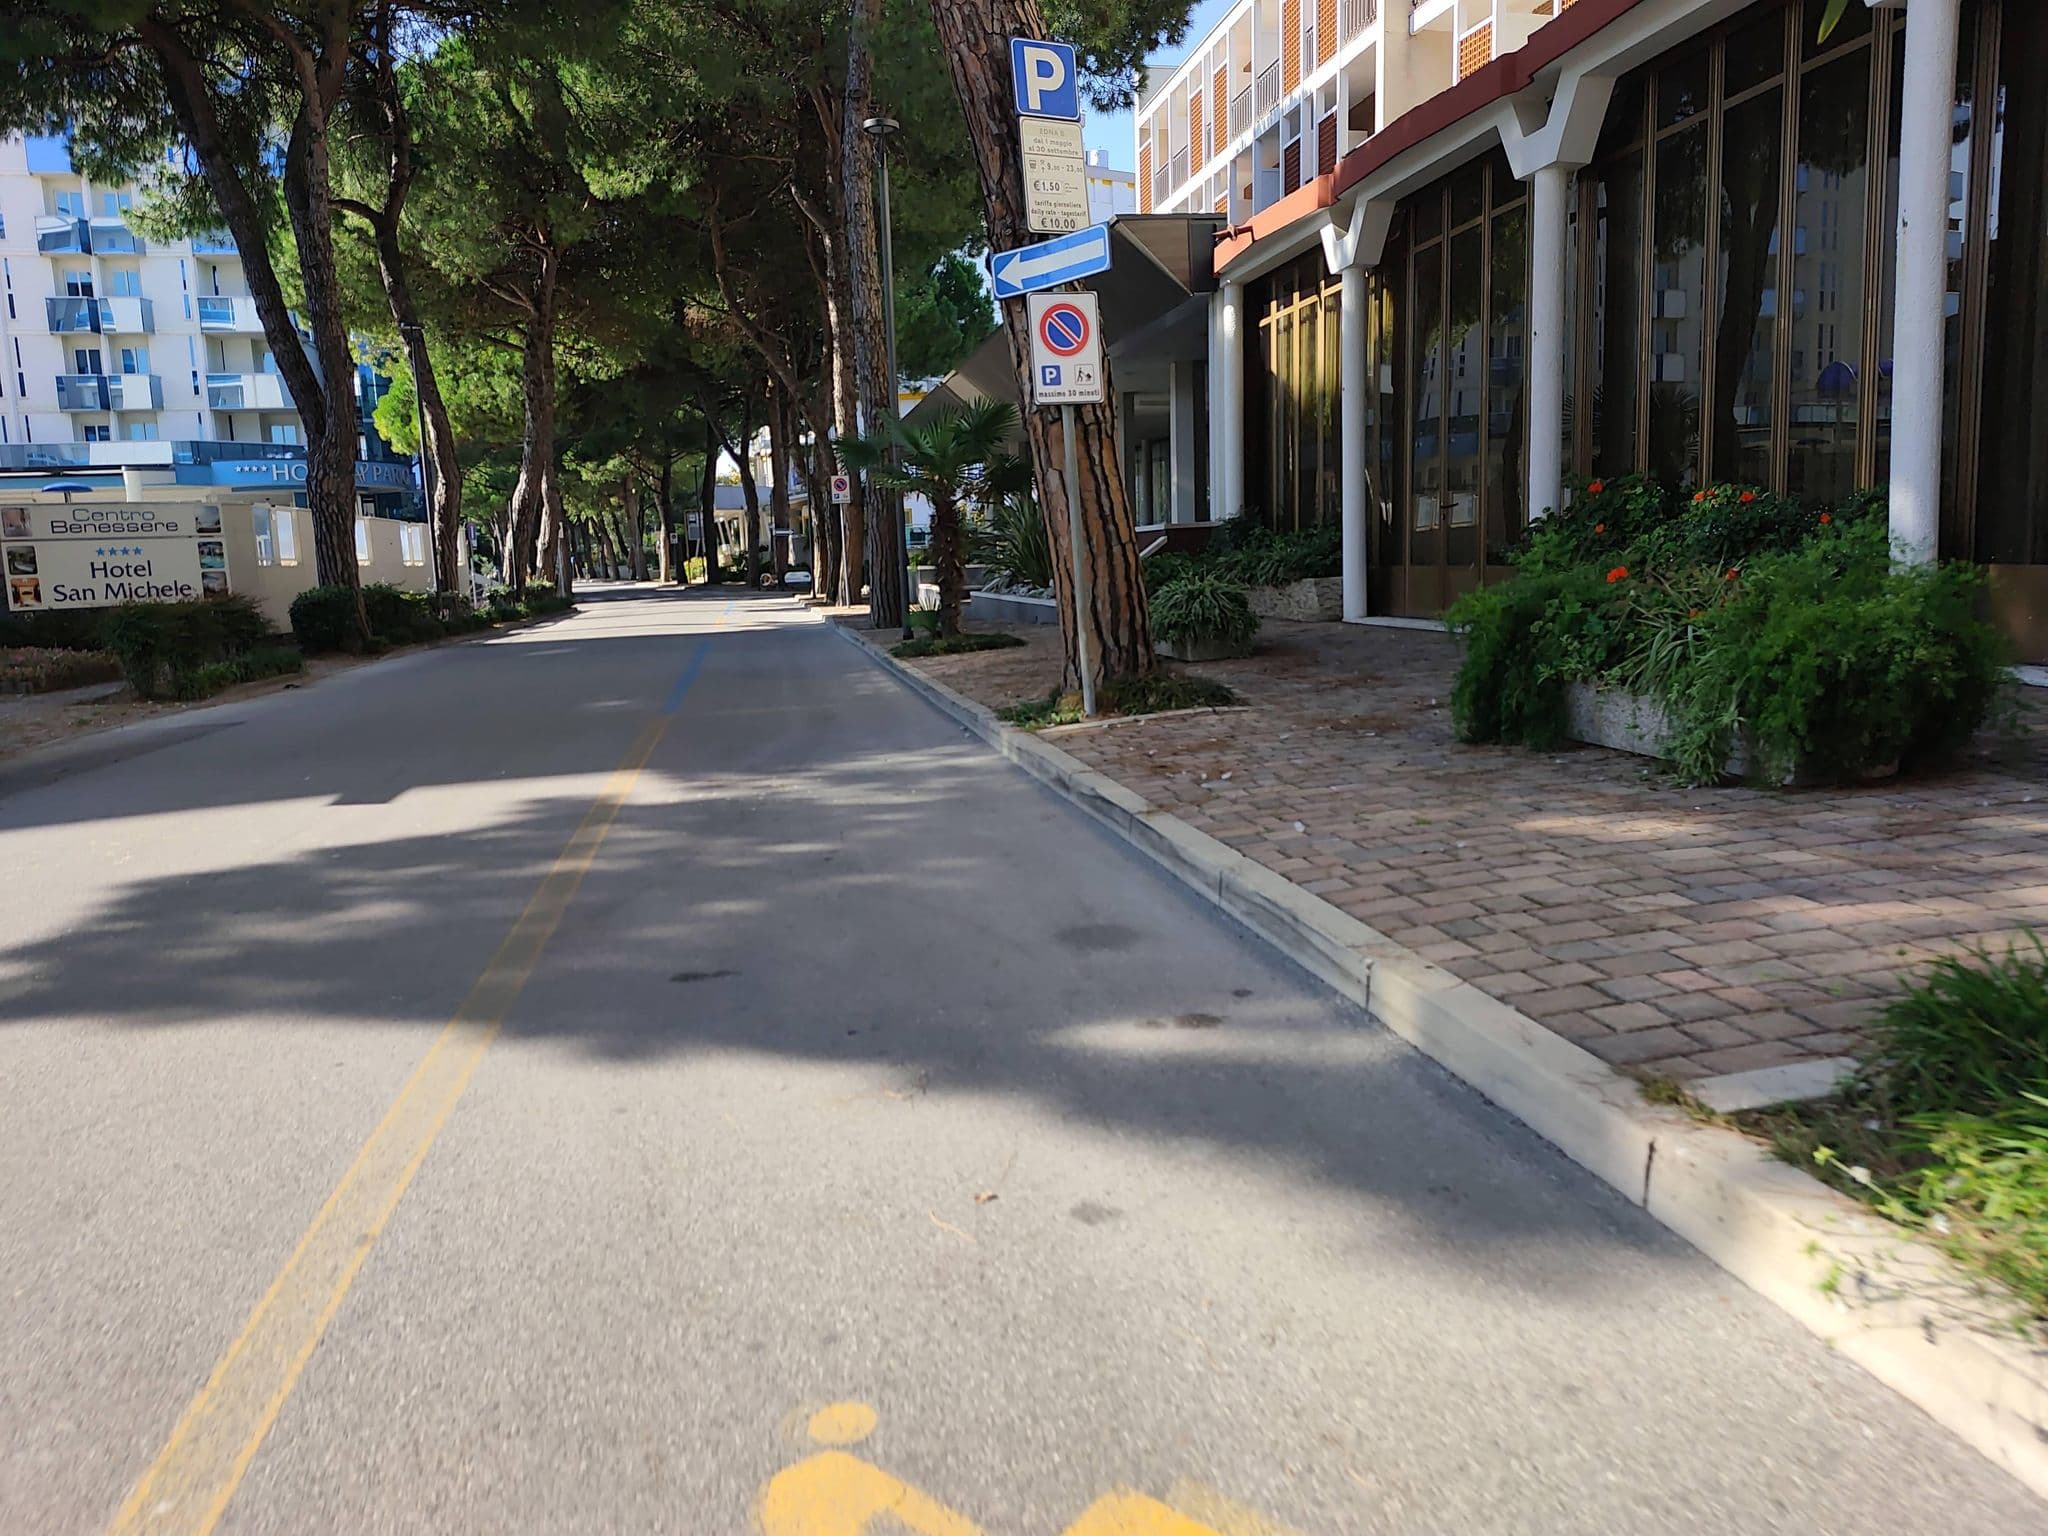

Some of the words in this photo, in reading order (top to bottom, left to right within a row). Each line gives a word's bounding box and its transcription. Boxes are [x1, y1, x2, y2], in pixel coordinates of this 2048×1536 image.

[1024, 46, 1065, 110] P
[1045, 368, 1057, 384] P
[72, 508, 156, 522] Centro
[51, 520, 178, 534] Benessere
[90, 560, 152, 579] Hotel
[53, 584, 96, 602] San
[105, 580, 192, 600] Michele
